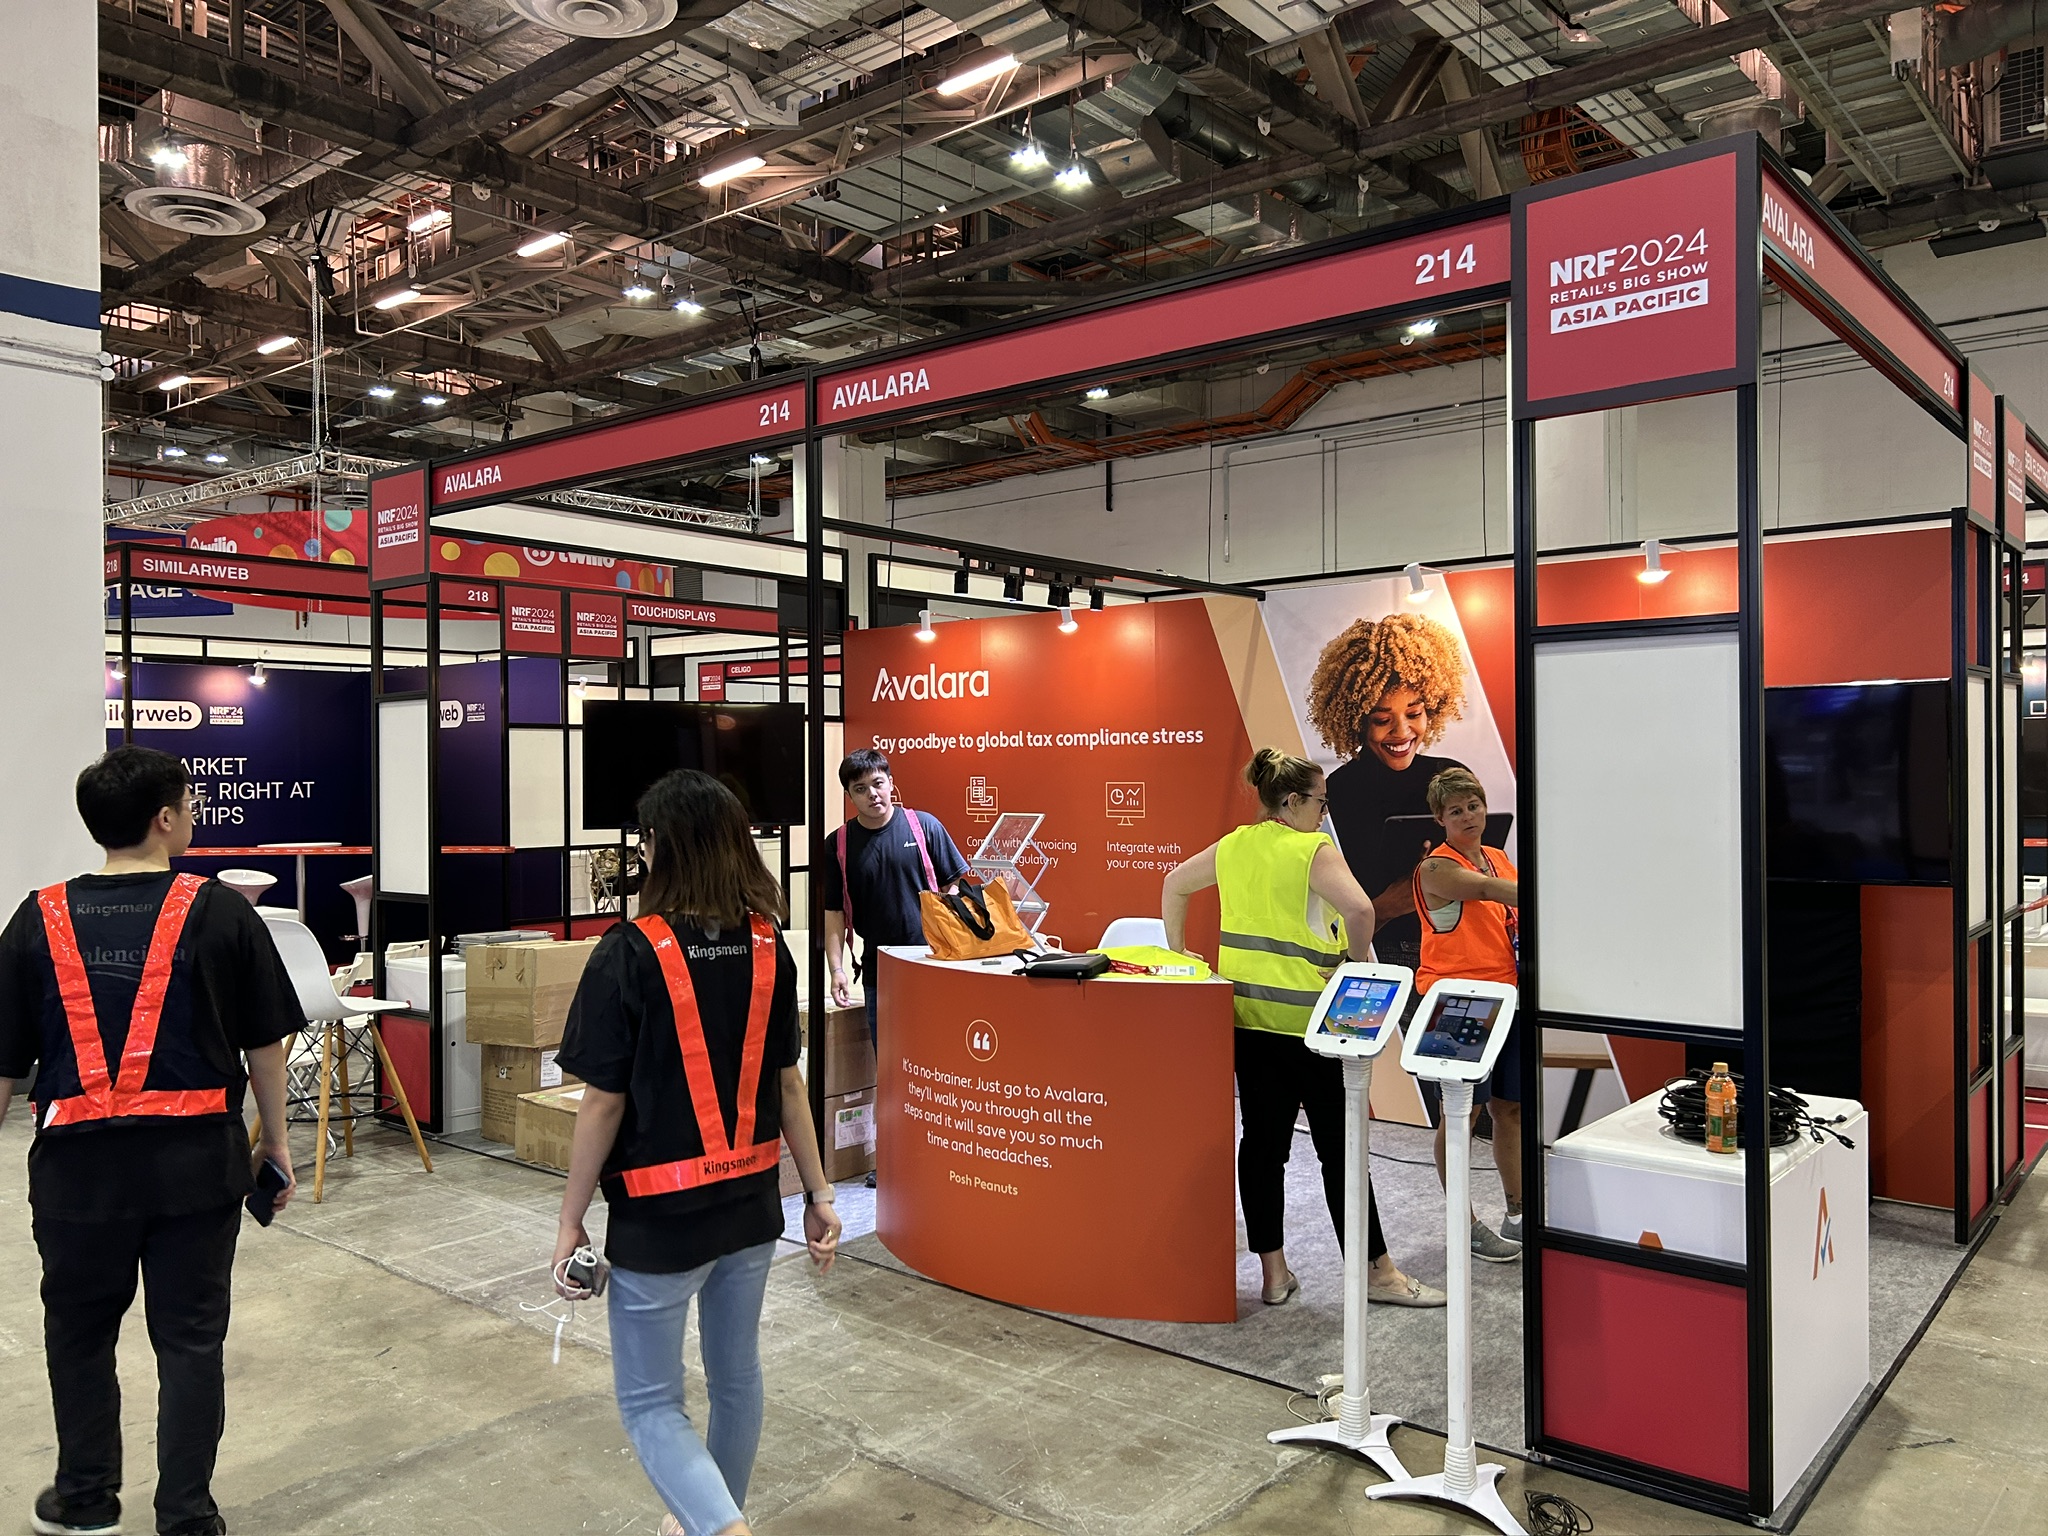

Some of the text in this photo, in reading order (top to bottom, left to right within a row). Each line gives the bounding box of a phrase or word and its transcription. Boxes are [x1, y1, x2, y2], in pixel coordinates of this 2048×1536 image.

[1762, 192, 1815, 269] AVALARA
[1415, 243, 1476, 285] 214
[1550, 261, 1708, 304] RETAIL'S BIG SHOW
[1558, 287, 1701, 328] ASIA PACIFIC
[832, 368, 930, 410] AVALARA
[759, 400, 790, 427] 214
[444, 465, 502, 495] AVALARA
[380, 532, 416, 545] ASIA PACIFIC
[106, 559, 118, 573] 218
[143, 558, 249, 580] SIMILARWEB
[467, 589, 489, 603] 218
[631, 604, 717, 624] TOUCHDISPLAYS
[731, 666, 751, 674] CELIGO
[872, 663, 990, 702] Avalara
[872, 727, 1204, 755] Say goodbye to global tax compliance stress
[219, 782, 283, 800] RIGHT
[290, 782, 315, 799] AT
[1106, 840, 1181, 856] Integrate with
[1106, 860, 1130, 871] your
[1132, 860, 1154, 870] core
[76, 903, 154, 917] Kingsmen
[688, 943, 747, 960] Kingsmen
[902, 1057, 1108, 1106] It's a no-brainer. Just go to Avalara,
[908, 1081, 1092, 1126] they'll walk you through all the
[904, 1102, 1103, 1150] steps and it will save you so much
[927, 1130, 1053, 1169] time and headaches.
[703, 1155, 757, 1176] Kingsmen
[949, 1170, 1018, 1196] Posh Peanuts
